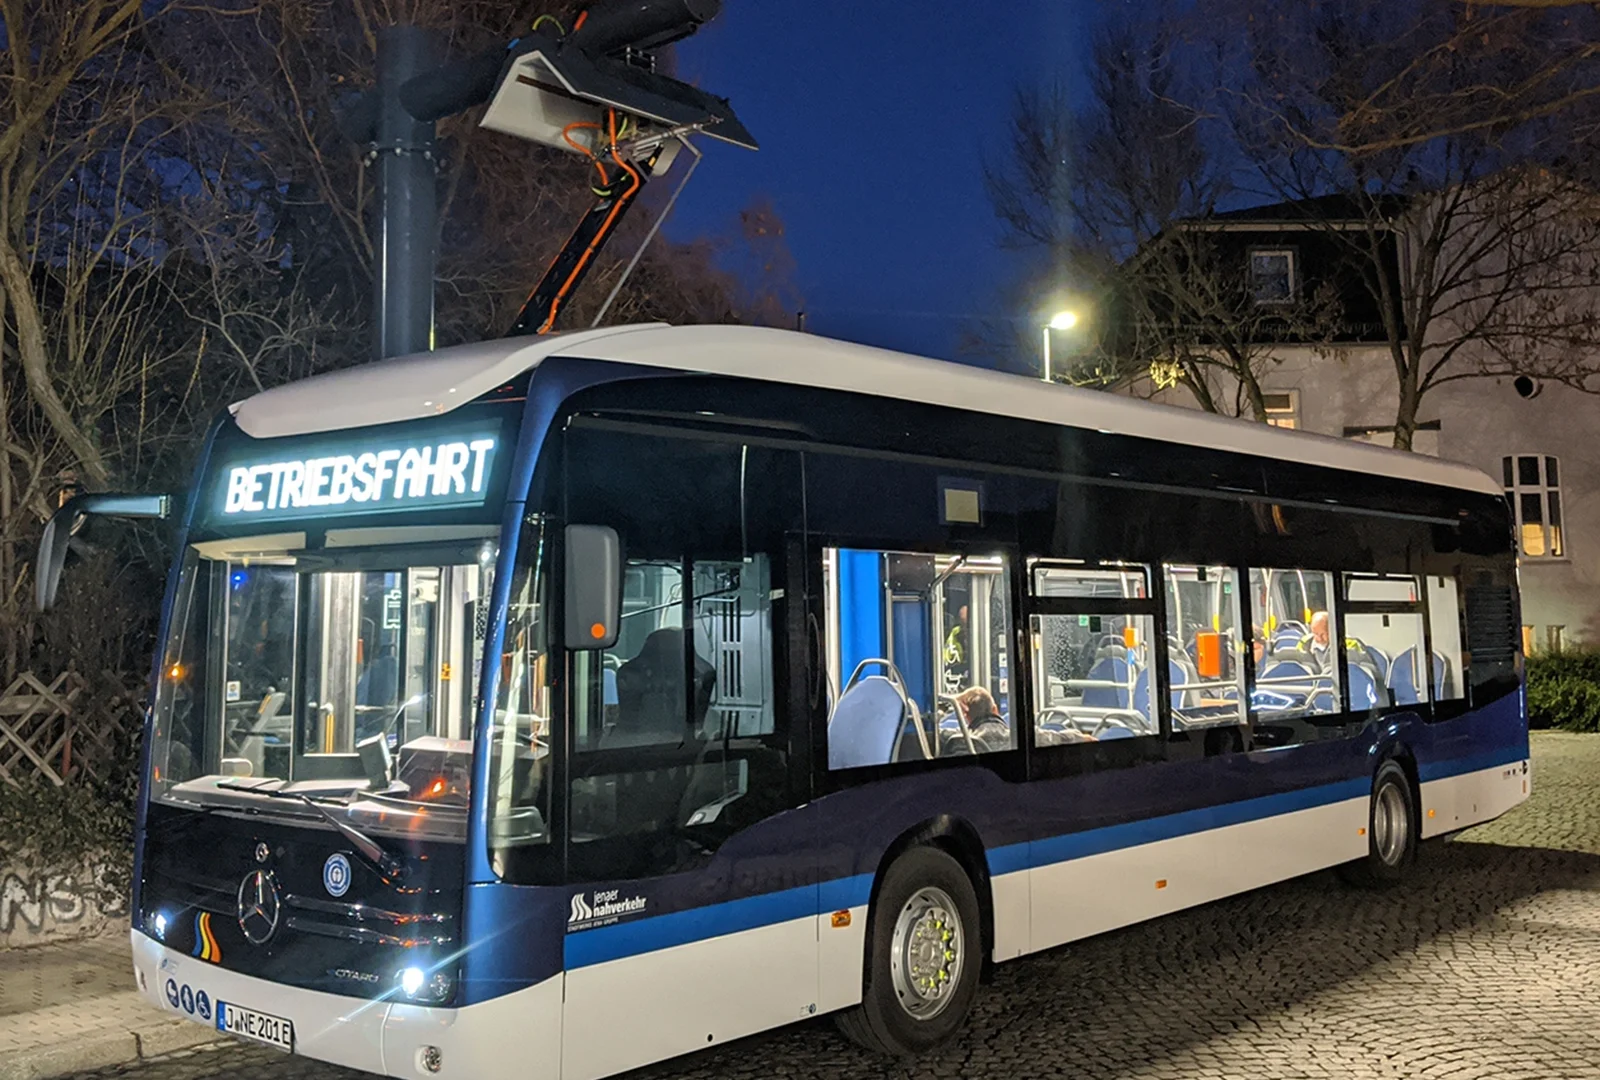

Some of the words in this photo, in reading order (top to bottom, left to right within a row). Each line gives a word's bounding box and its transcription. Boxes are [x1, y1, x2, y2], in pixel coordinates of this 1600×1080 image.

[225, 439, 494, 514] BETRIEBSFAHRT
[593, 889, 619, 907] jenaer
[593, 895, 647, 918] nahverkehr
